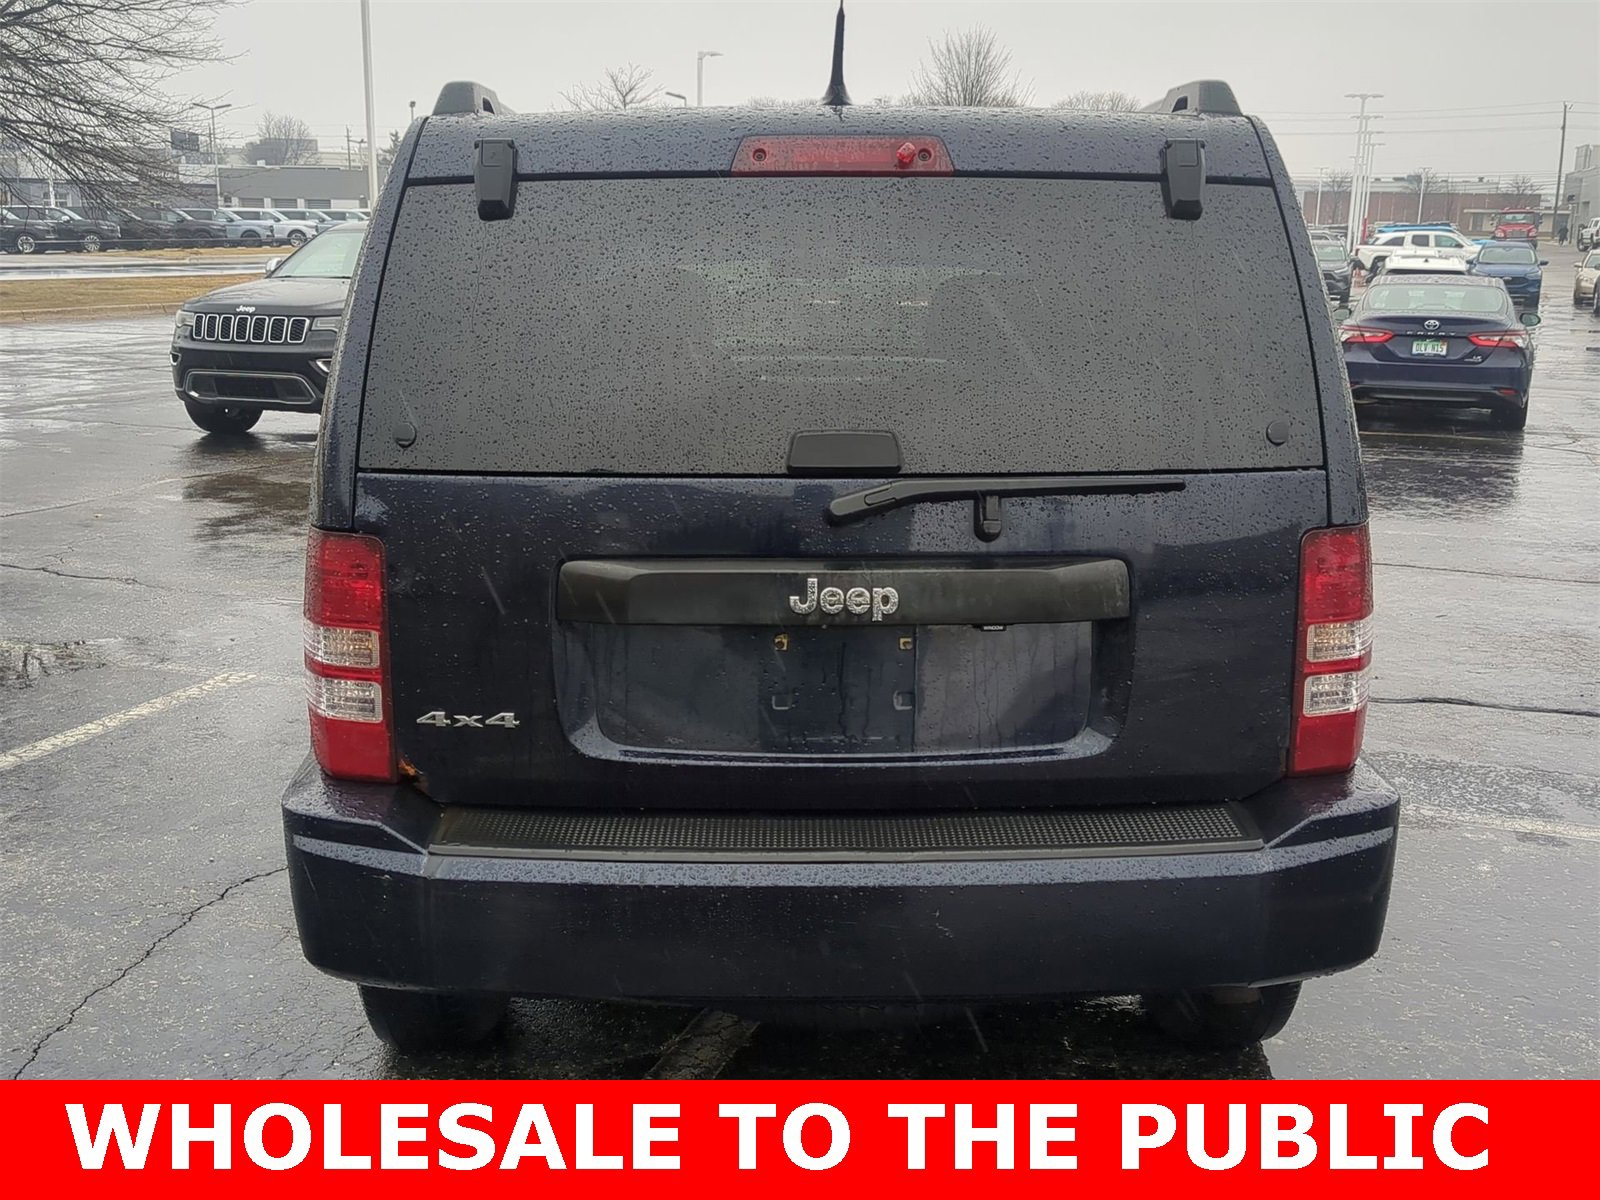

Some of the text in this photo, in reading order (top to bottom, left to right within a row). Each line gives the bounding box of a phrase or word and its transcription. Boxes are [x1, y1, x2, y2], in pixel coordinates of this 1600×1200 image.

[236, 305, 256, 313] Jeep
[789, 578, 899, 621] Jeep
[416, 711, 520, 728] 4x4
